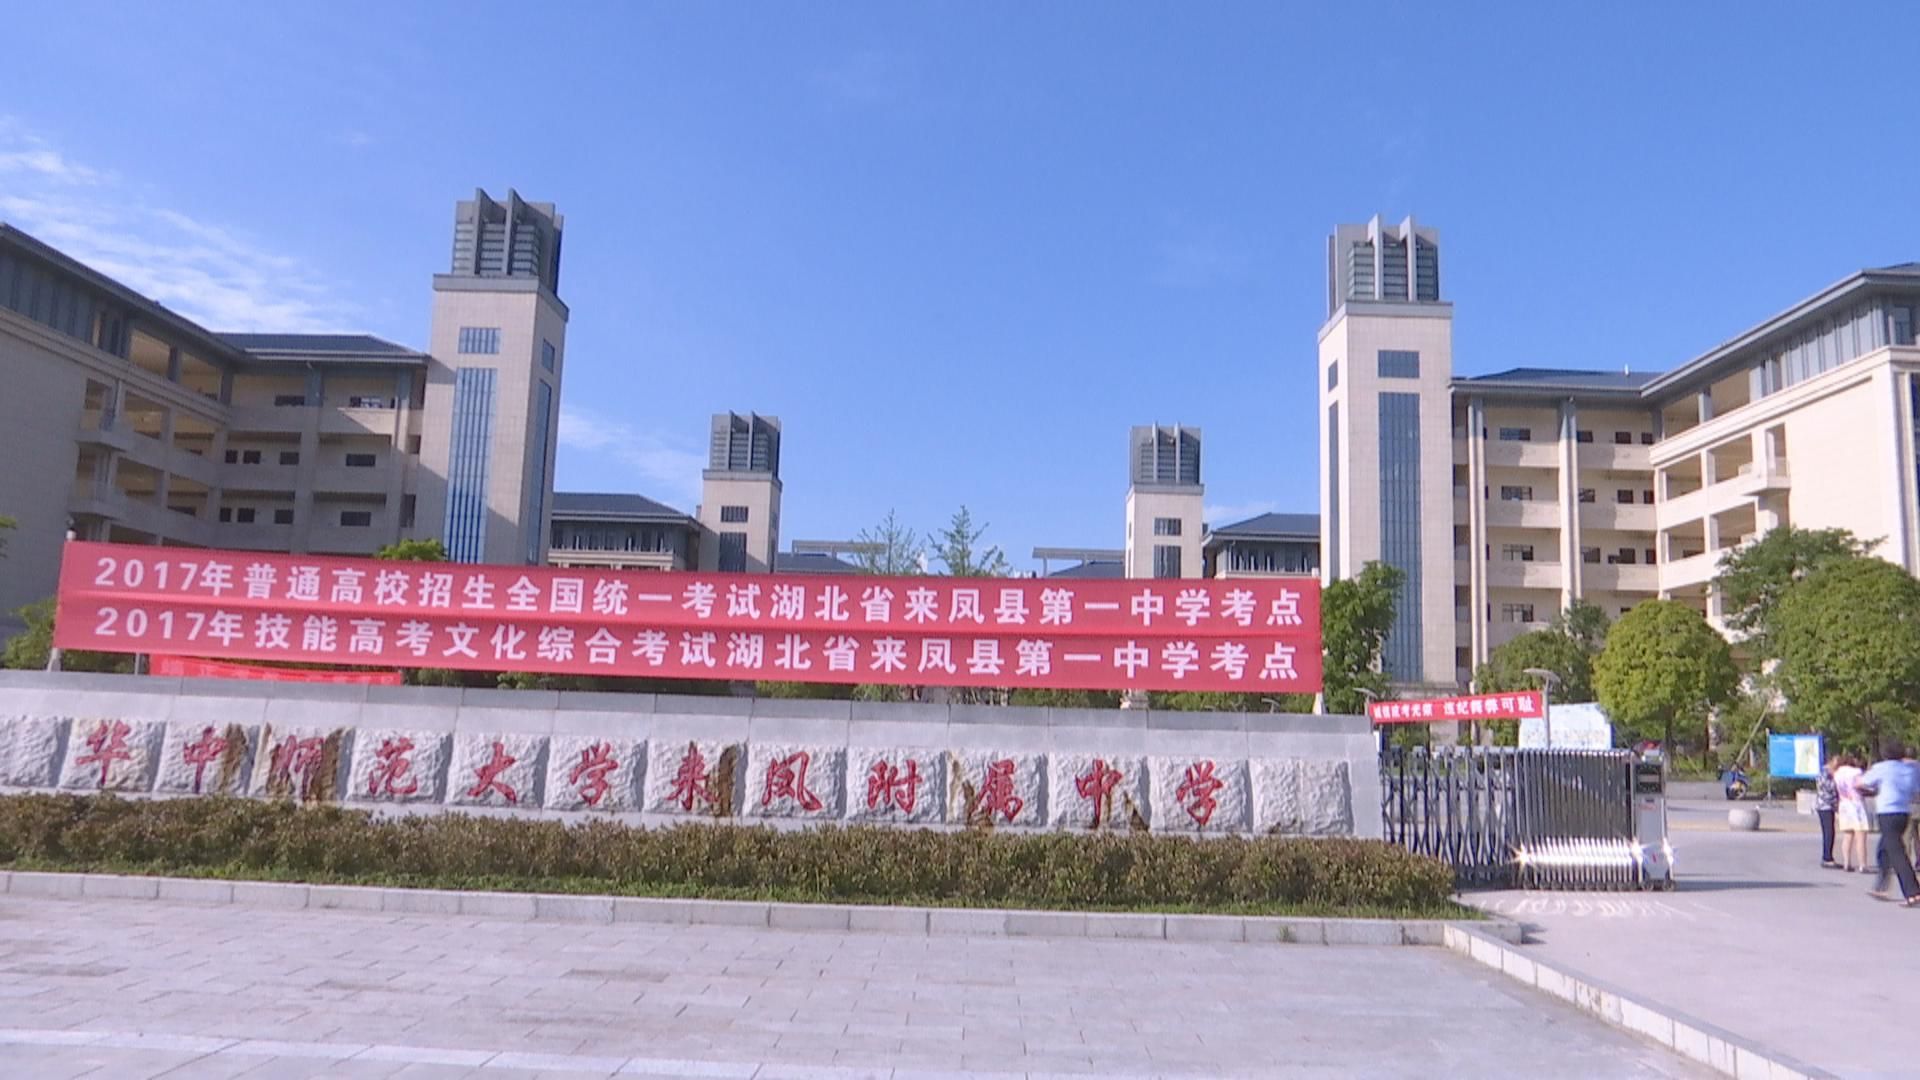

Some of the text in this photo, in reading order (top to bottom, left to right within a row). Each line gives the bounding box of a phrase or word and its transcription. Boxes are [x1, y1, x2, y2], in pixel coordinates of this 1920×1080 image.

[95, 557, 1303, 627] 2017年普通高校招生全国统一考试湖北省来凤县第一中学考点
[95, 607, 1299, 681] 2017年技能高考文化综合考试湖北省来凤县第一中学考点
